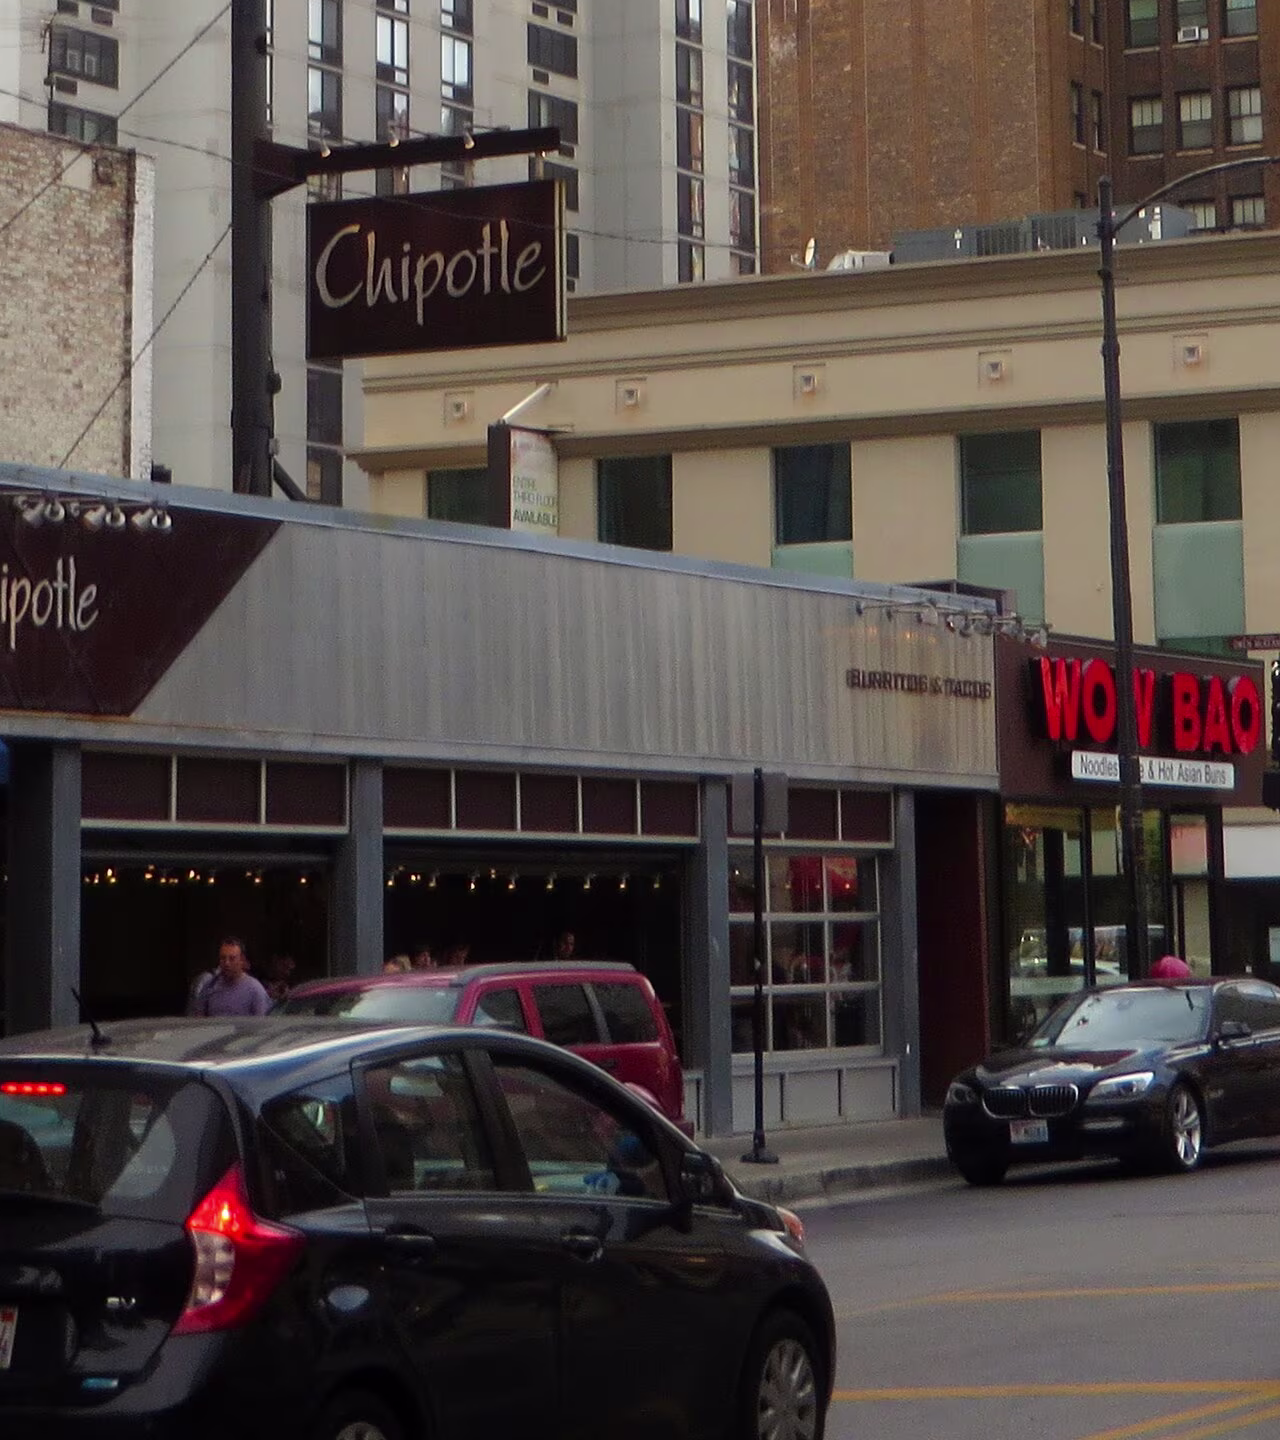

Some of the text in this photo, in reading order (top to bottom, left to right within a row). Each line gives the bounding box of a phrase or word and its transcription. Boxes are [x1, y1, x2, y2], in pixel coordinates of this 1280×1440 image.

[315, 218, 547, 326] Chipotle
[513, 509, 558, 528] AVAILABLE
[846, 668, 928, 693] BURRITOS
[944, 676, 992, 700] TACOS
[1172, 671, 1261, 755] BAO
[1148, 760, 1155, 780] &
[1158, 761, 1174, 782] Hot
[1177, 762, 1202, 784] Asian
[1204, 764, 1226, 785] Buns
